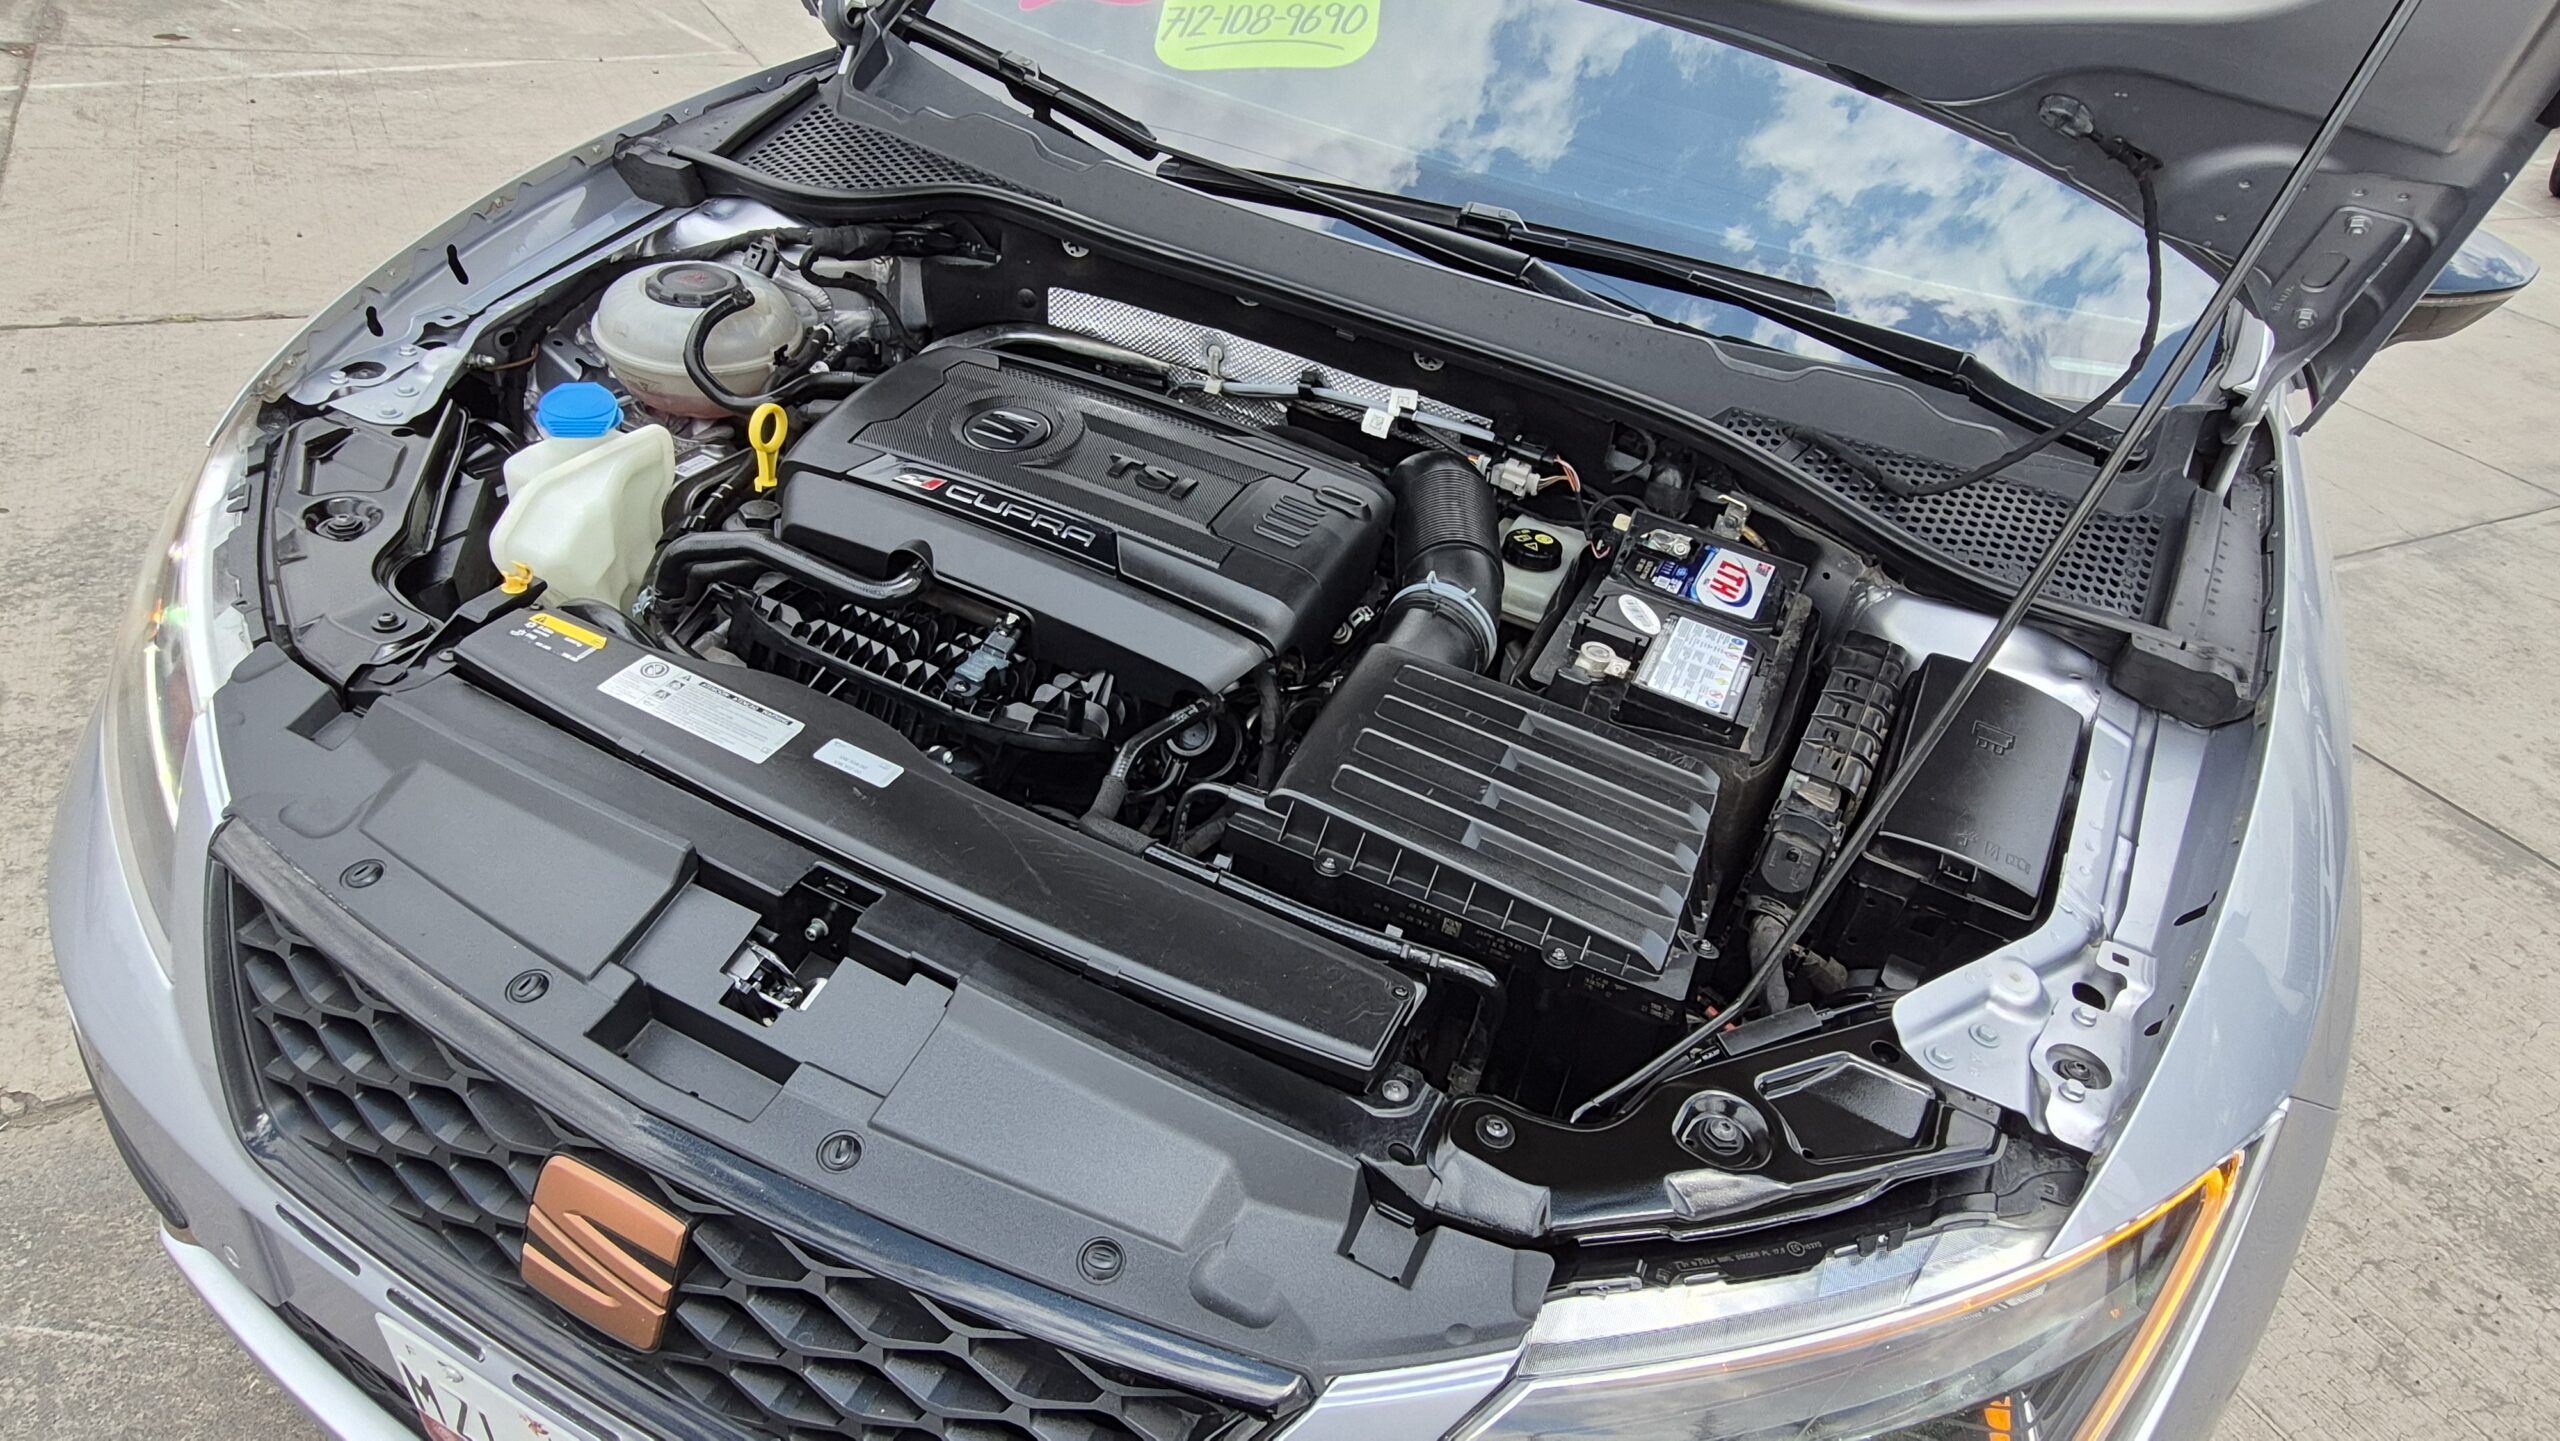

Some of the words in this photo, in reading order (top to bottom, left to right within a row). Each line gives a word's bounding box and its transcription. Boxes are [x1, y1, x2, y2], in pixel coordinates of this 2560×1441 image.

[1161, 3, 1369, 41] 712-108-9690
[1106, 453, 1199, 499] TSI
[945, 484, 1097, 548] CUPRA
[1709, 560, 1748, 600] LTH
